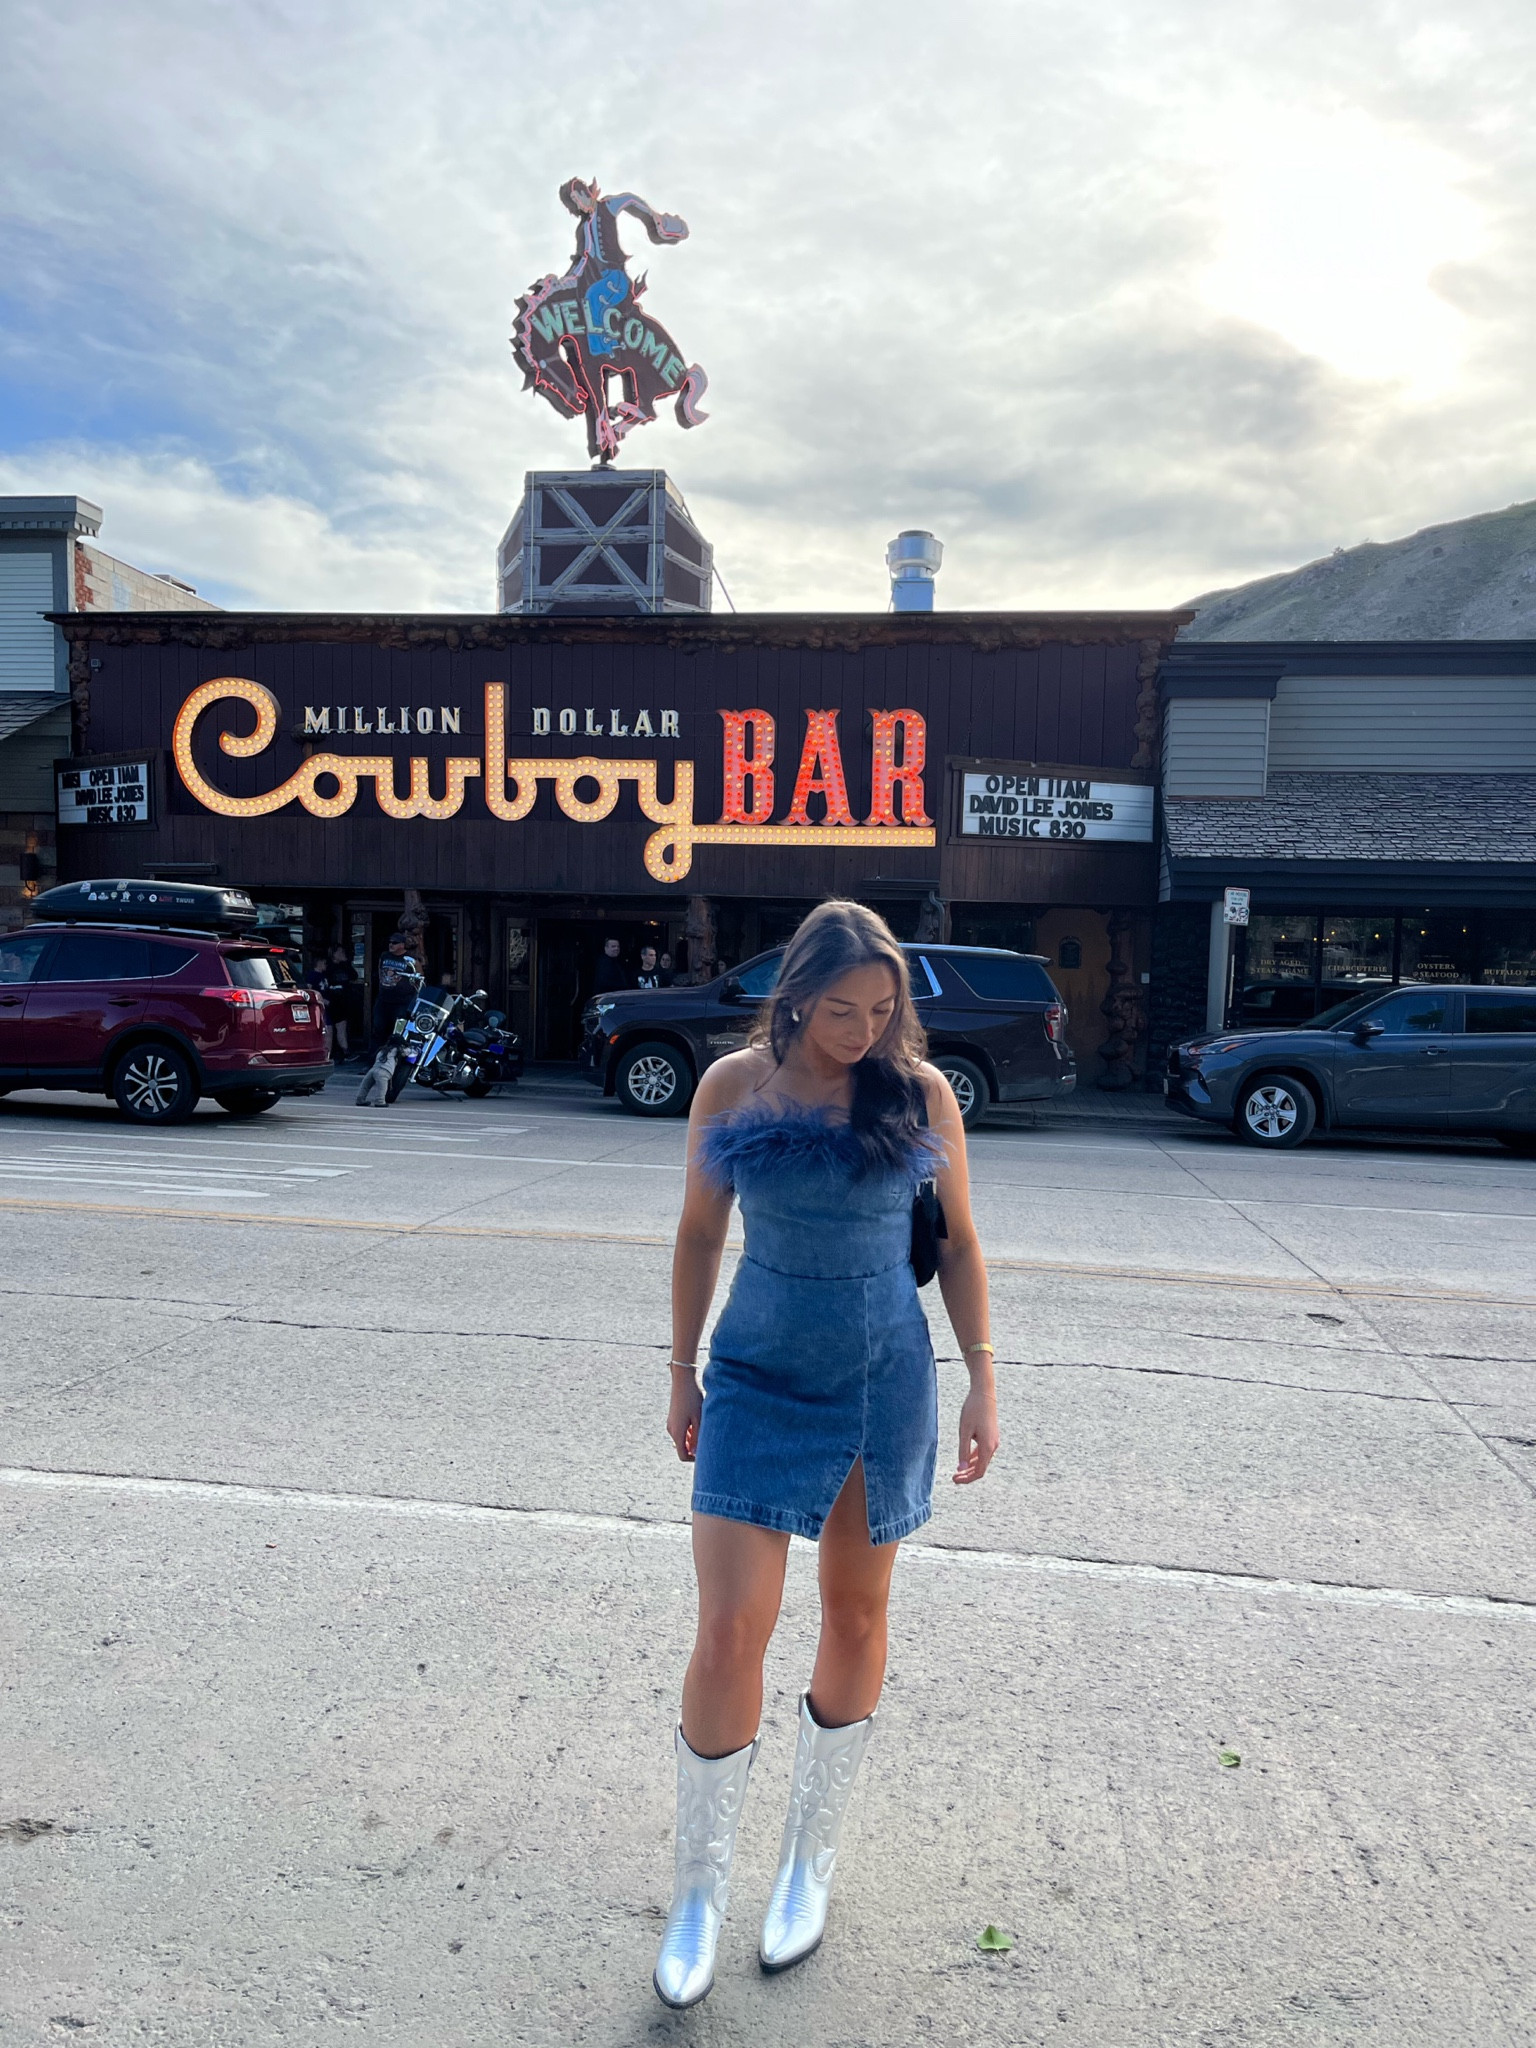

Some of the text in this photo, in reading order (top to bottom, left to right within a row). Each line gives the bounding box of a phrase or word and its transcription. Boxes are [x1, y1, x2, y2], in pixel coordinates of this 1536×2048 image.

[530, 300, 686, 388] WELCOME
[303, 706, 681, 738] MILLION DOLLAR
[89, 768, 115, 787] OPEN
[172, 676, 934, 883] Cowboy BAR
[985, 775, 1040, 797] OPEN
[98, 787, 113, 804] LEE
[114, 784, 144, 803] JONES
[969, 795, 1113, 821] DAVID LEE JONES
[979, 816, 1086, 839] MUSIC 830
[1419, 971, 1460, 979] SEAFOOD
[1484, 968, 1521, 976] BUFFALO
